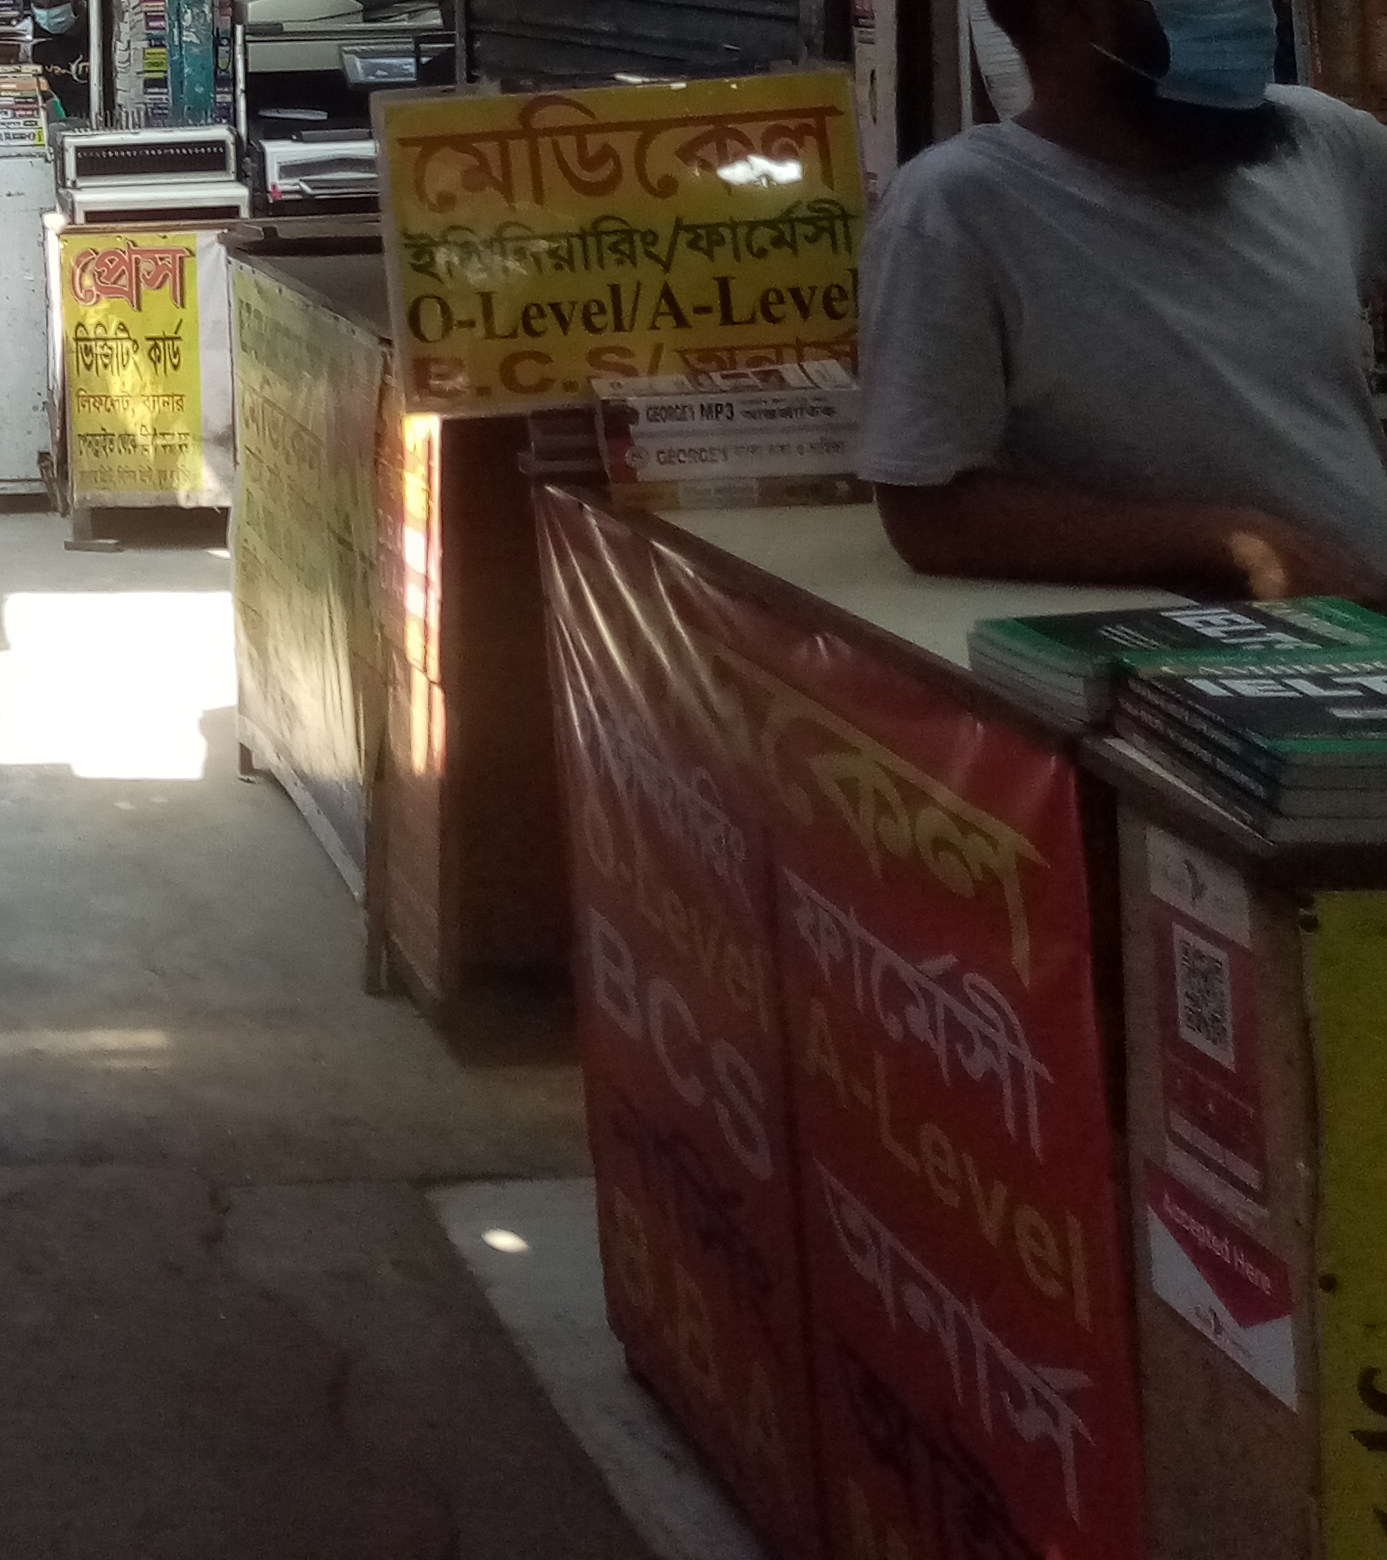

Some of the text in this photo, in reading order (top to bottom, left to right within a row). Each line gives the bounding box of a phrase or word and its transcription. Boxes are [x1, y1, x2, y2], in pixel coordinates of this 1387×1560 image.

[399, 95, 844, 213] মেডিকেল
[72, 240, 195, 312] প্রেস
[699, 402, 735, 421] MP3
[589, 906, 773, 1182] BCS
[804, 1010, 1093, 1333] A-Level
